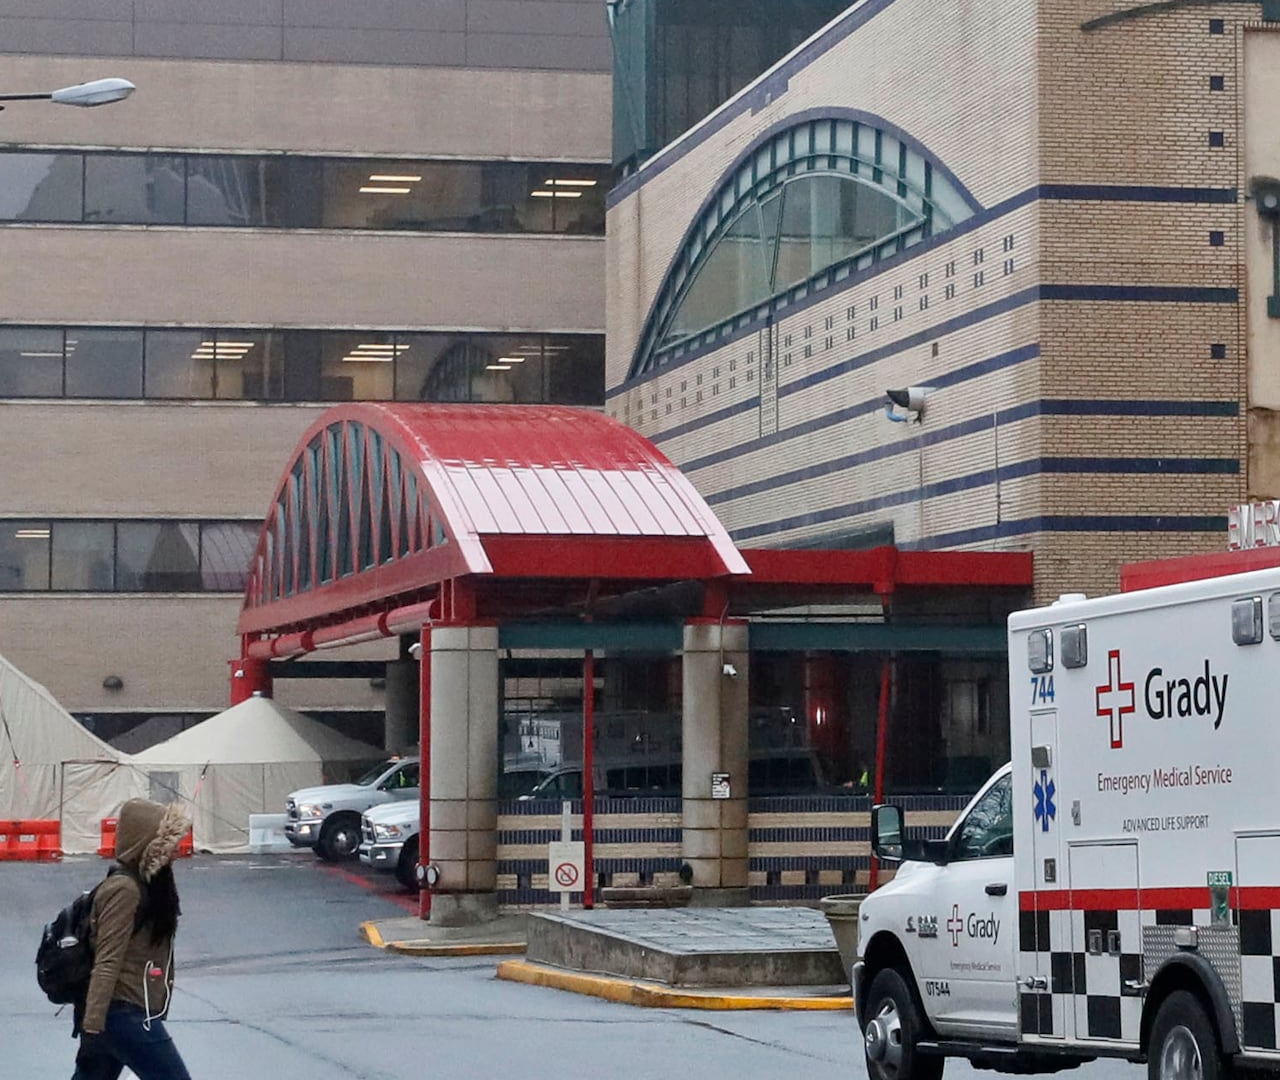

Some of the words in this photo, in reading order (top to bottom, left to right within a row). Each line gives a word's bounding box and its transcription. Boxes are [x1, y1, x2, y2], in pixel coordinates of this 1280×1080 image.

[1031, 677, 1055, 705] 744
[1144, 659, 1229, 730] Grady
[1097, 772, 1151, 795] Emergency
[1153, 766, 1192, 788] Medical
[1195, 764, 1232, 785] Service
[1122, 817, 1160, 832] ADVANCED
[1161, 817, 1176, 831] LIFE
[1177, 815, 1209, 830] SUPPORT
[1208, 872, 1229, 885] DIESEL
[967, 912, 1000, 945] Grady
